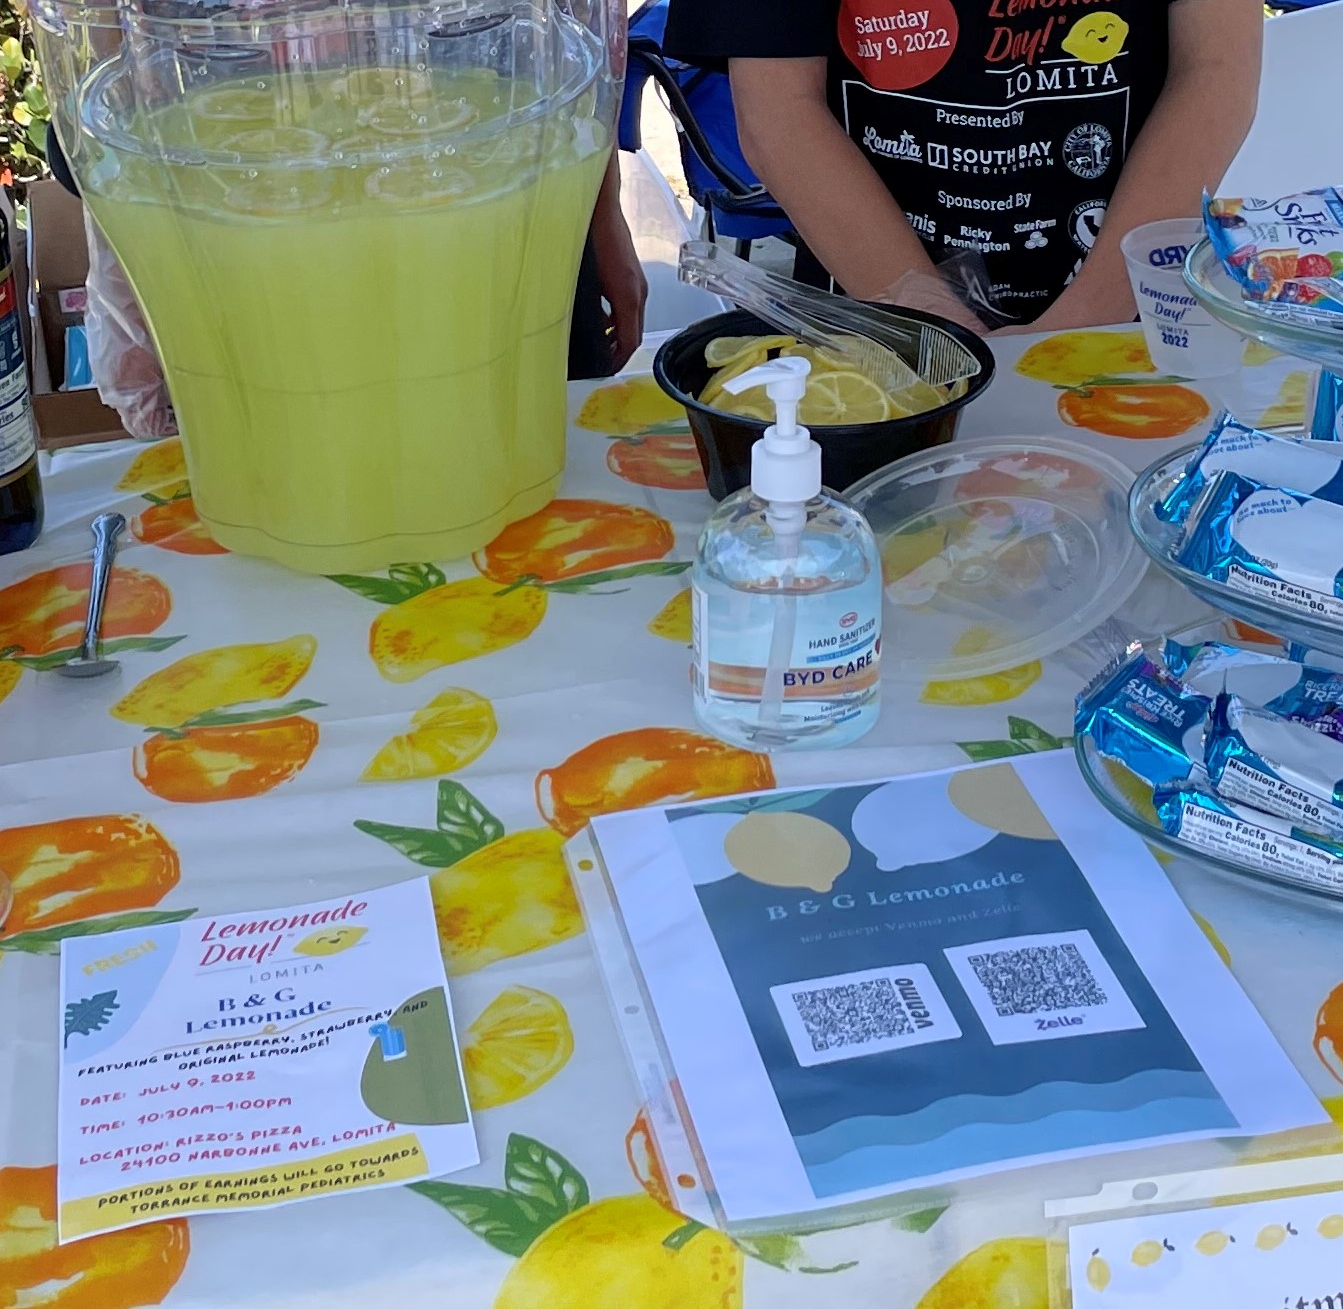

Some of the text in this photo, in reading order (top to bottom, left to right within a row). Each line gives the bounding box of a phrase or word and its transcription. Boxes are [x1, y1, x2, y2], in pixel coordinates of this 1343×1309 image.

[855, 9, 930, 35] Saturday
[857, 29, 950, 60] July 9, 2022
[984, 15, 1054, 65] Day!
[1006, 63, 1118, 98] LOMITA
[936, 108, 1024, 128] Presented By
[862, 125, 922, 160] Lomita
[952, 141, 1052, 165] SOUTH BAY
[953, 164, 1007, 175] CREDIT
[937, 190, 1032, 211] Sponsored By
[960, 226, 992, 241] Ricky
[1014, 222, 1035, 234] State
[1162, 333, 1188, 349] 2022
[808, 618, 875, 650] HAND SANITIZER
[783, 671, 825, 687] BYD
[832, 649, 873, 679] CARE
[1228, 758, 1309, 803] Nutrition Facts
[766, 870, 1025, 922] B & G Lemonade
[201, 899, 367, 944] Lemonade
[199, 935, 280, 966] Day!
[249, 963, 324, 983] LOMITA
[218, 987, 296, 1012] B & G
[895, 978, 934, 1029] venmo
[186, 1000, 331, 1034] Lemonade
[1034, 1015, 1083, 1031] Zelle
[178, 1037, 329, 1070] ORIGINAL LEMONADE!
[80, 1092, 125, 1106] DATE:
[139, 1081, 180, 1096] JULY
[211, 1071, 255, 1083] 2022
[80, 1097, 291, 1135] TIME: 10:30AM-1:00PM
[79, 1125, 303, 1165] LOCATION: RIZZO'S PIZZA
[121, 1152, 180, 1171] 24100
[188, 1143, 280, 1162] NARBONNE
[332, 1121, 397, 1144] LOMITA
[99, 1147, 419, 1208] PORTIONS OF EARNINGS WILL GO TOWARDS
[130, 1169, 386, 1214] TORRANCE MEMORIAL PEDIATRICS
